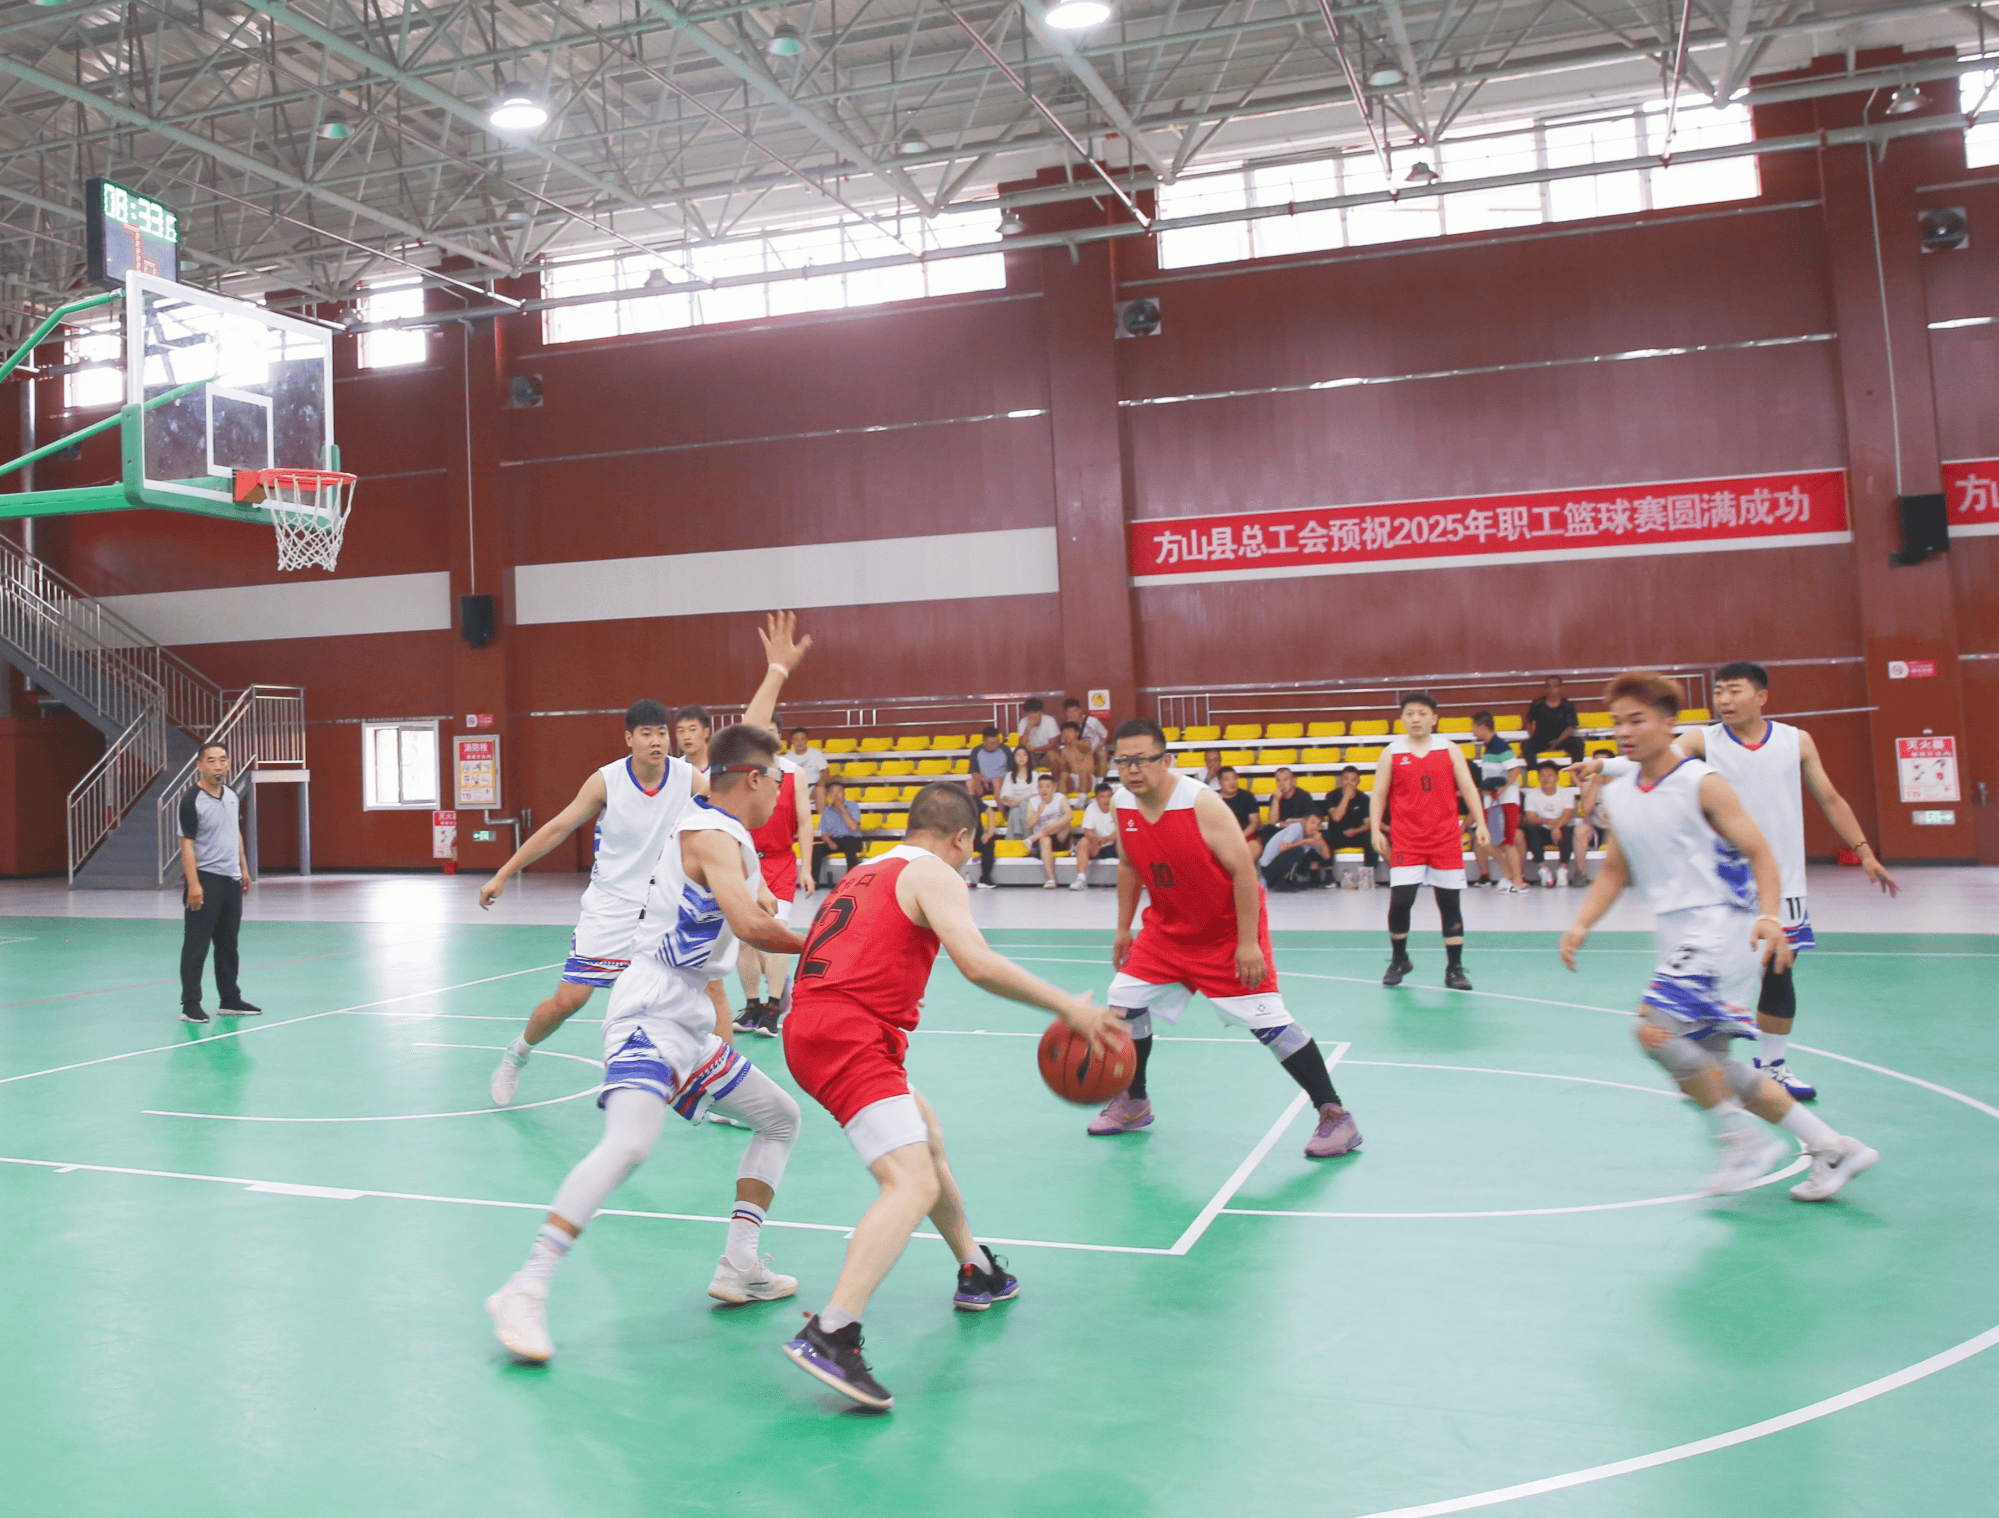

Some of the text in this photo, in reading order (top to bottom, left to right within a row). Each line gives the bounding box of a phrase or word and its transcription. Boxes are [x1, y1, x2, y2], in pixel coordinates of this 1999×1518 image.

[1153, 486, 1810, 564] 方山县总工会预祝2025年职工篮球赛圆满成功
[1150, 862, 1175, 888] 10
[1786, 897, 1801, 920] 11
[794, 894, 858, 983] 2
